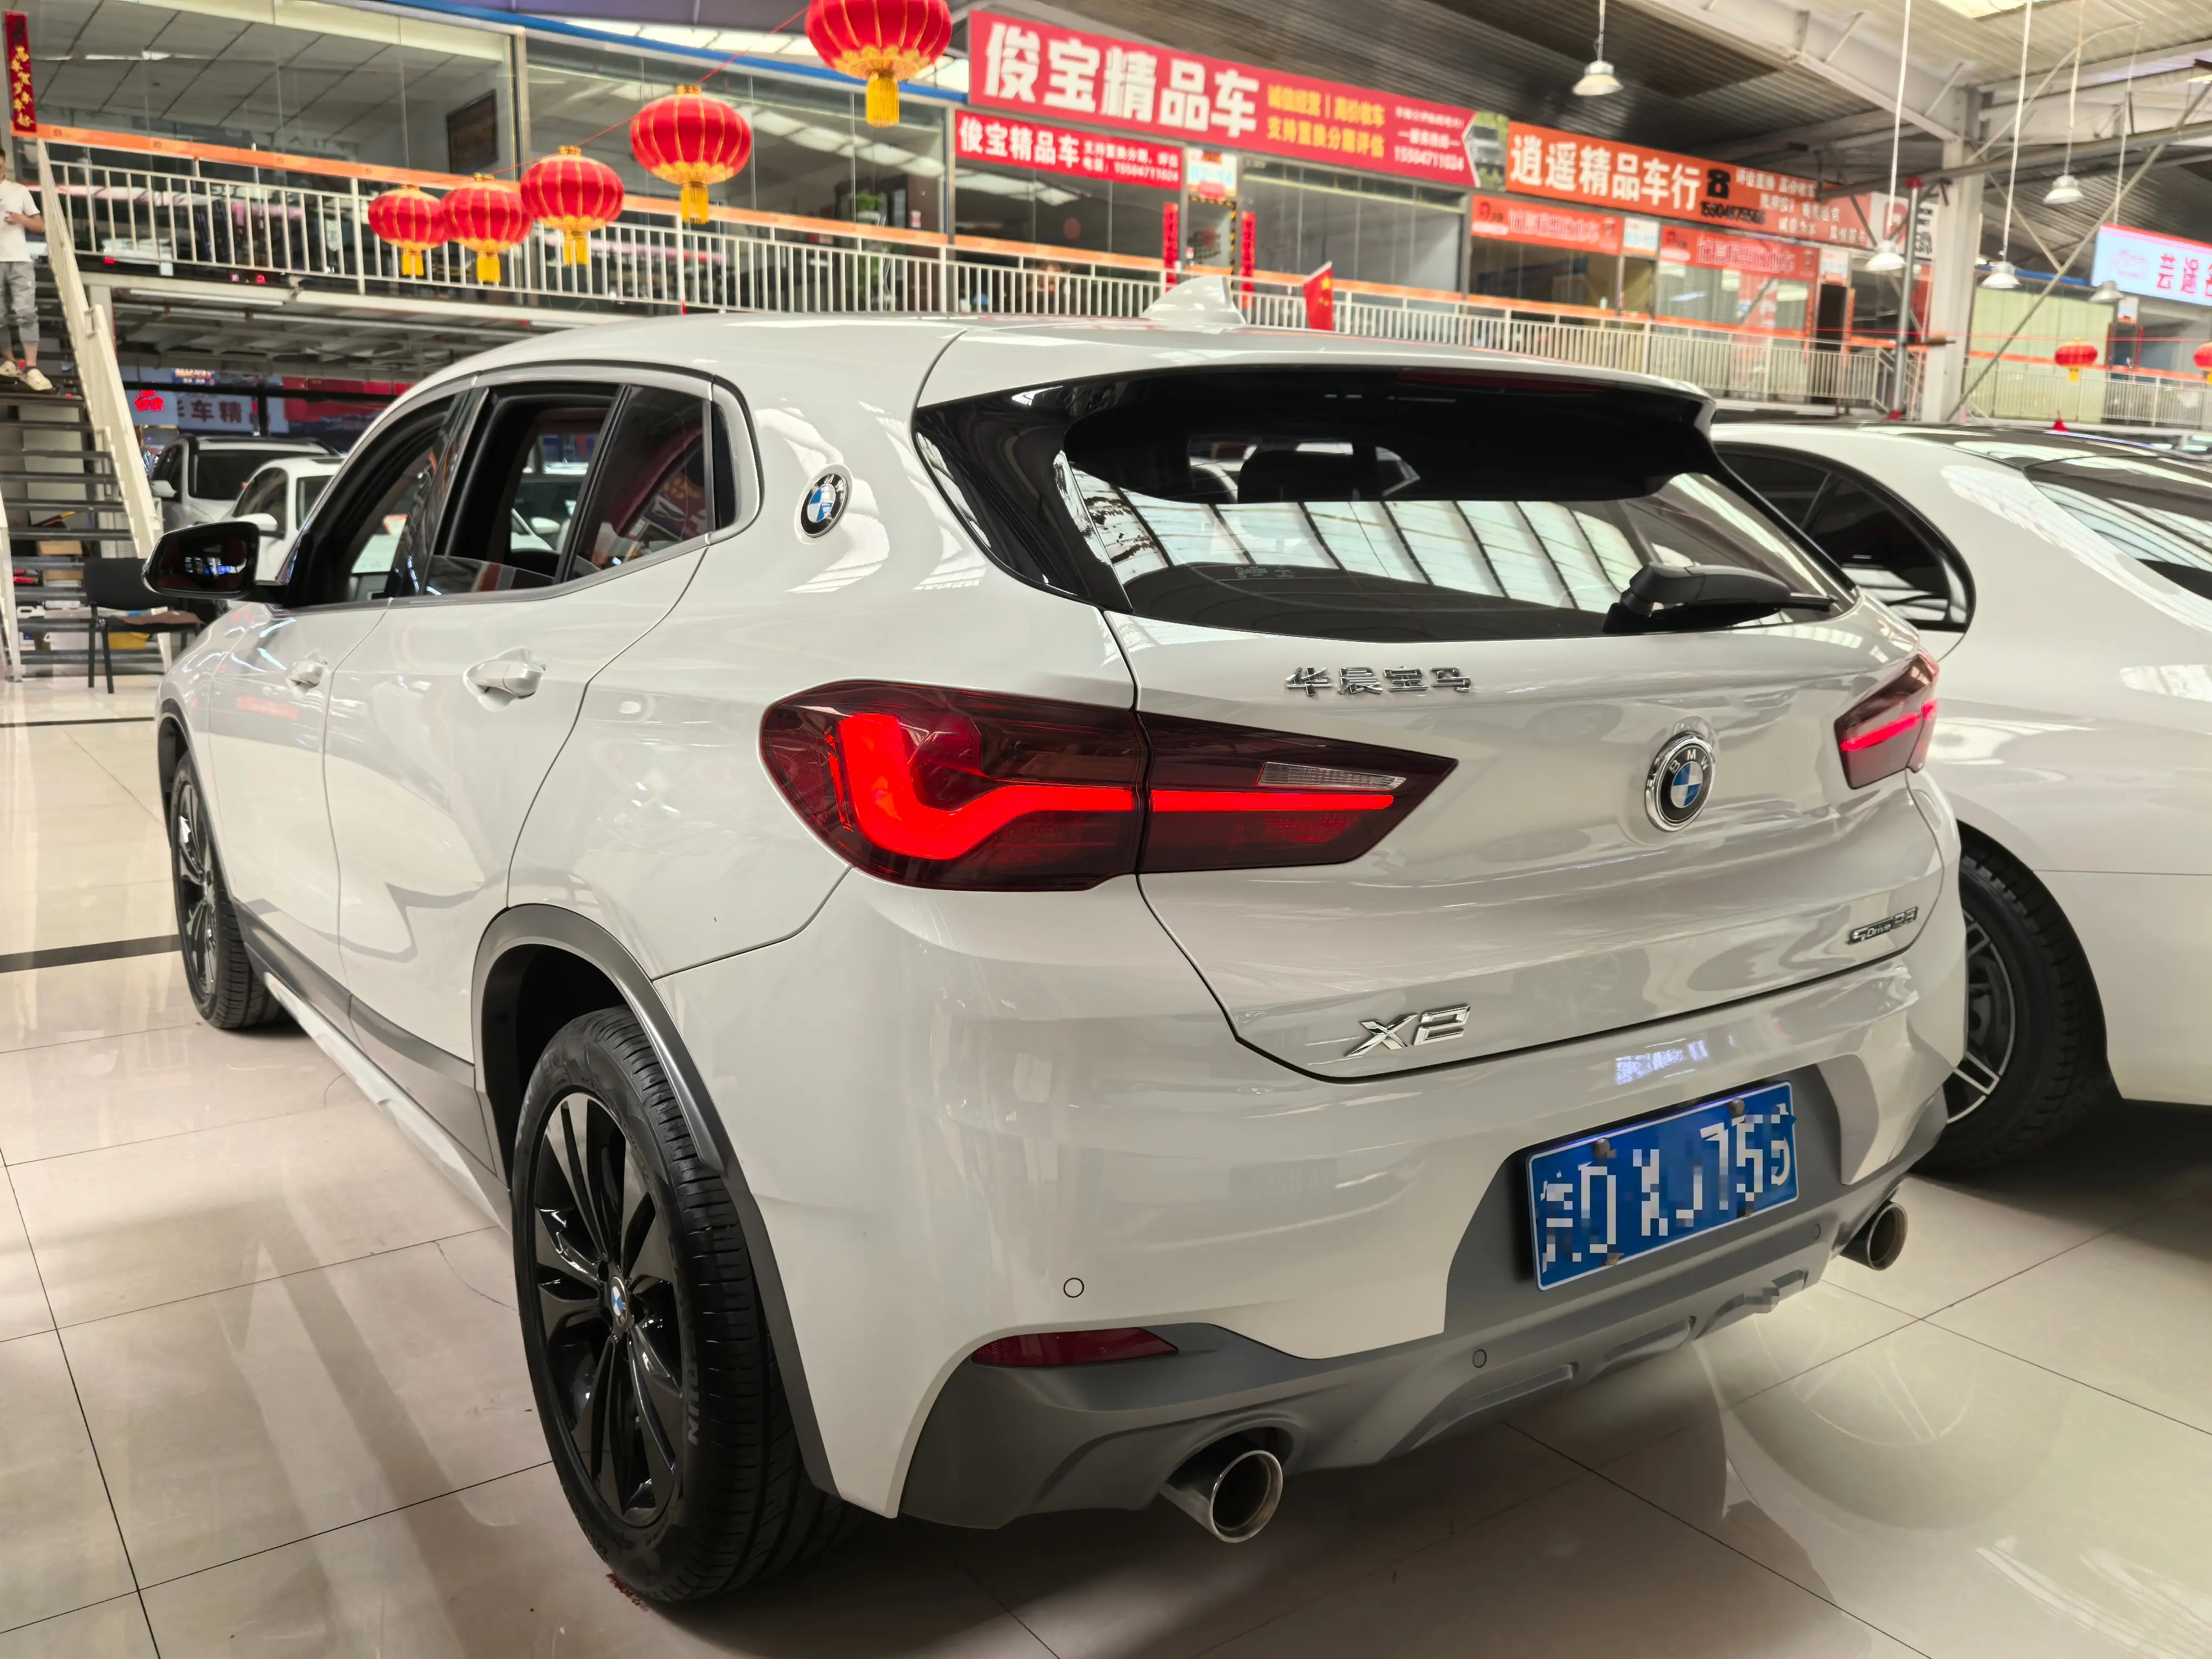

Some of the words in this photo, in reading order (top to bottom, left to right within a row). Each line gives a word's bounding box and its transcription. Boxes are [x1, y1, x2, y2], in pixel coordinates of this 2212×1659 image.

[983, 22, 1260, 139] 俊宝精品车
[959, 115, 1080, 168] 俊宝精品车
[1510, 134, 1701, 211] 逍遥精品车行
[1284, 665, 1472, 696] 华晨宝马
[1669, 748, 1709, 774] BMW
[1344, 1003, 1471, 1057] X2
